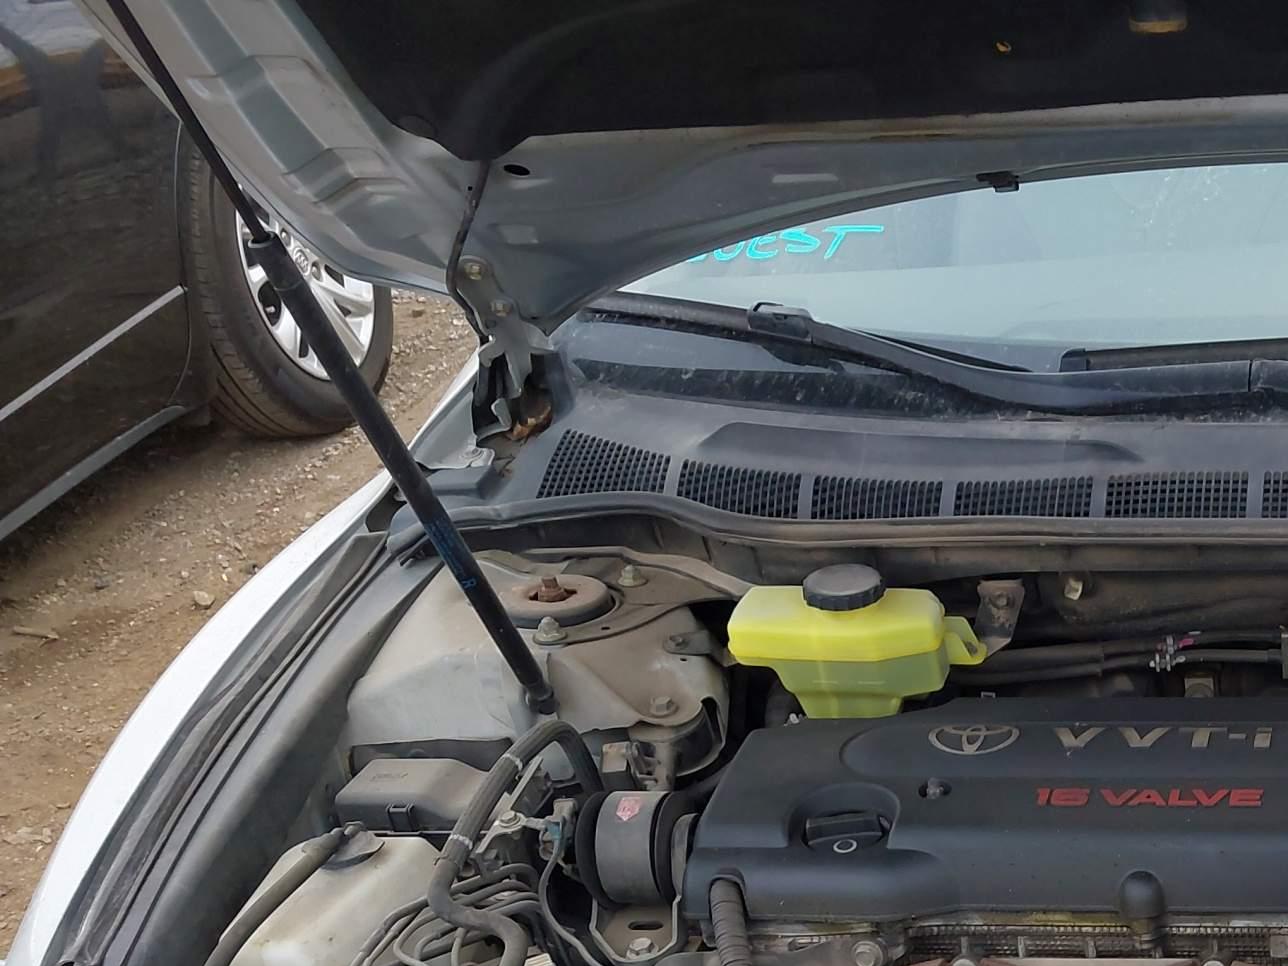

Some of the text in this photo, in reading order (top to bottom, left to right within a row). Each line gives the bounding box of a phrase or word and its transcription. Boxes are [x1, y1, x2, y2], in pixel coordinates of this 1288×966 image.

[687, 224, 884, 262] UEST
[1054, 727, 1273, 749] VVT-i
[1036, 788, 1265, 807] 16 VALVE
